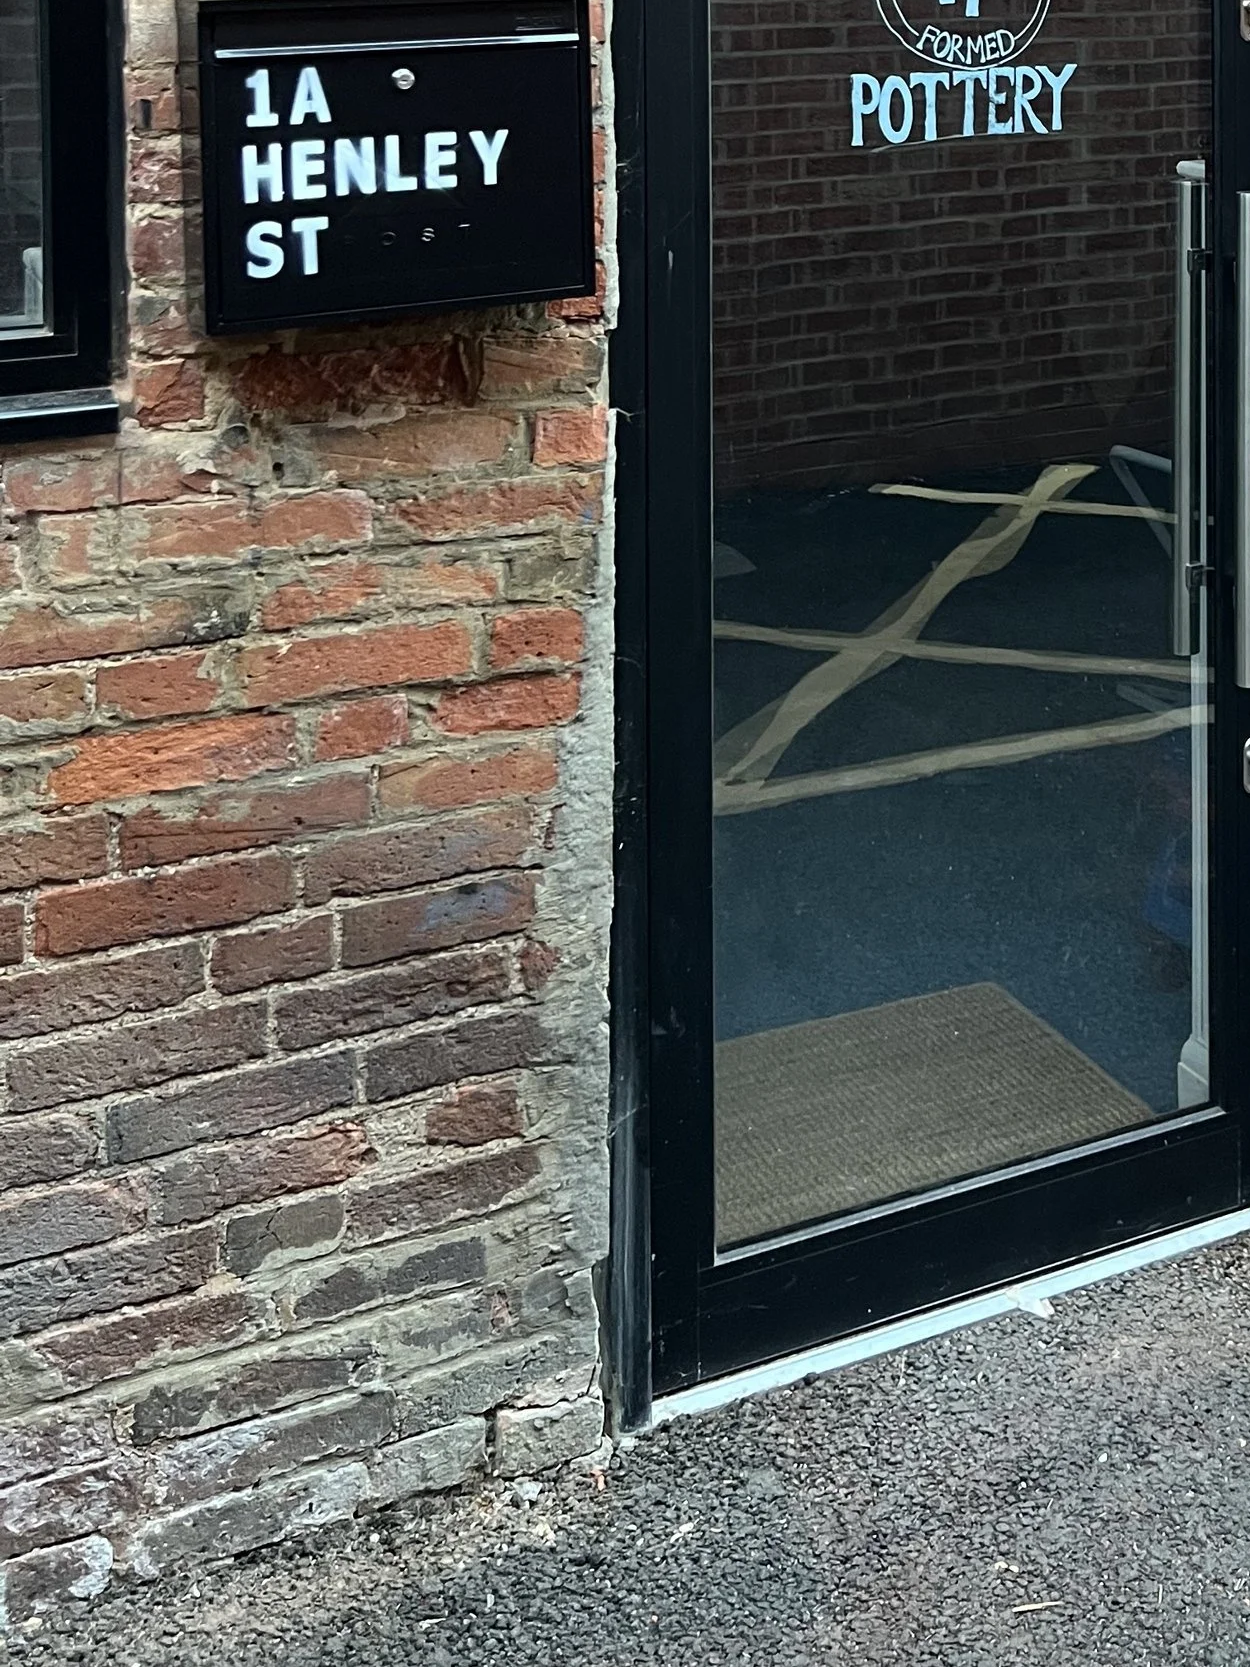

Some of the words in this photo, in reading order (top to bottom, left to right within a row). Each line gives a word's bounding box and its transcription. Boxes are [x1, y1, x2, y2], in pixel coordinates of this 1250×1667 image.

[917, 24, 1015, 65] FORMED
[244, 65, 333, 128] 1A
[850, 63, 1078, 147] POTTERY
[241, 128, 510, 204] HENLEY
[245, 215, 330, 280] ST
